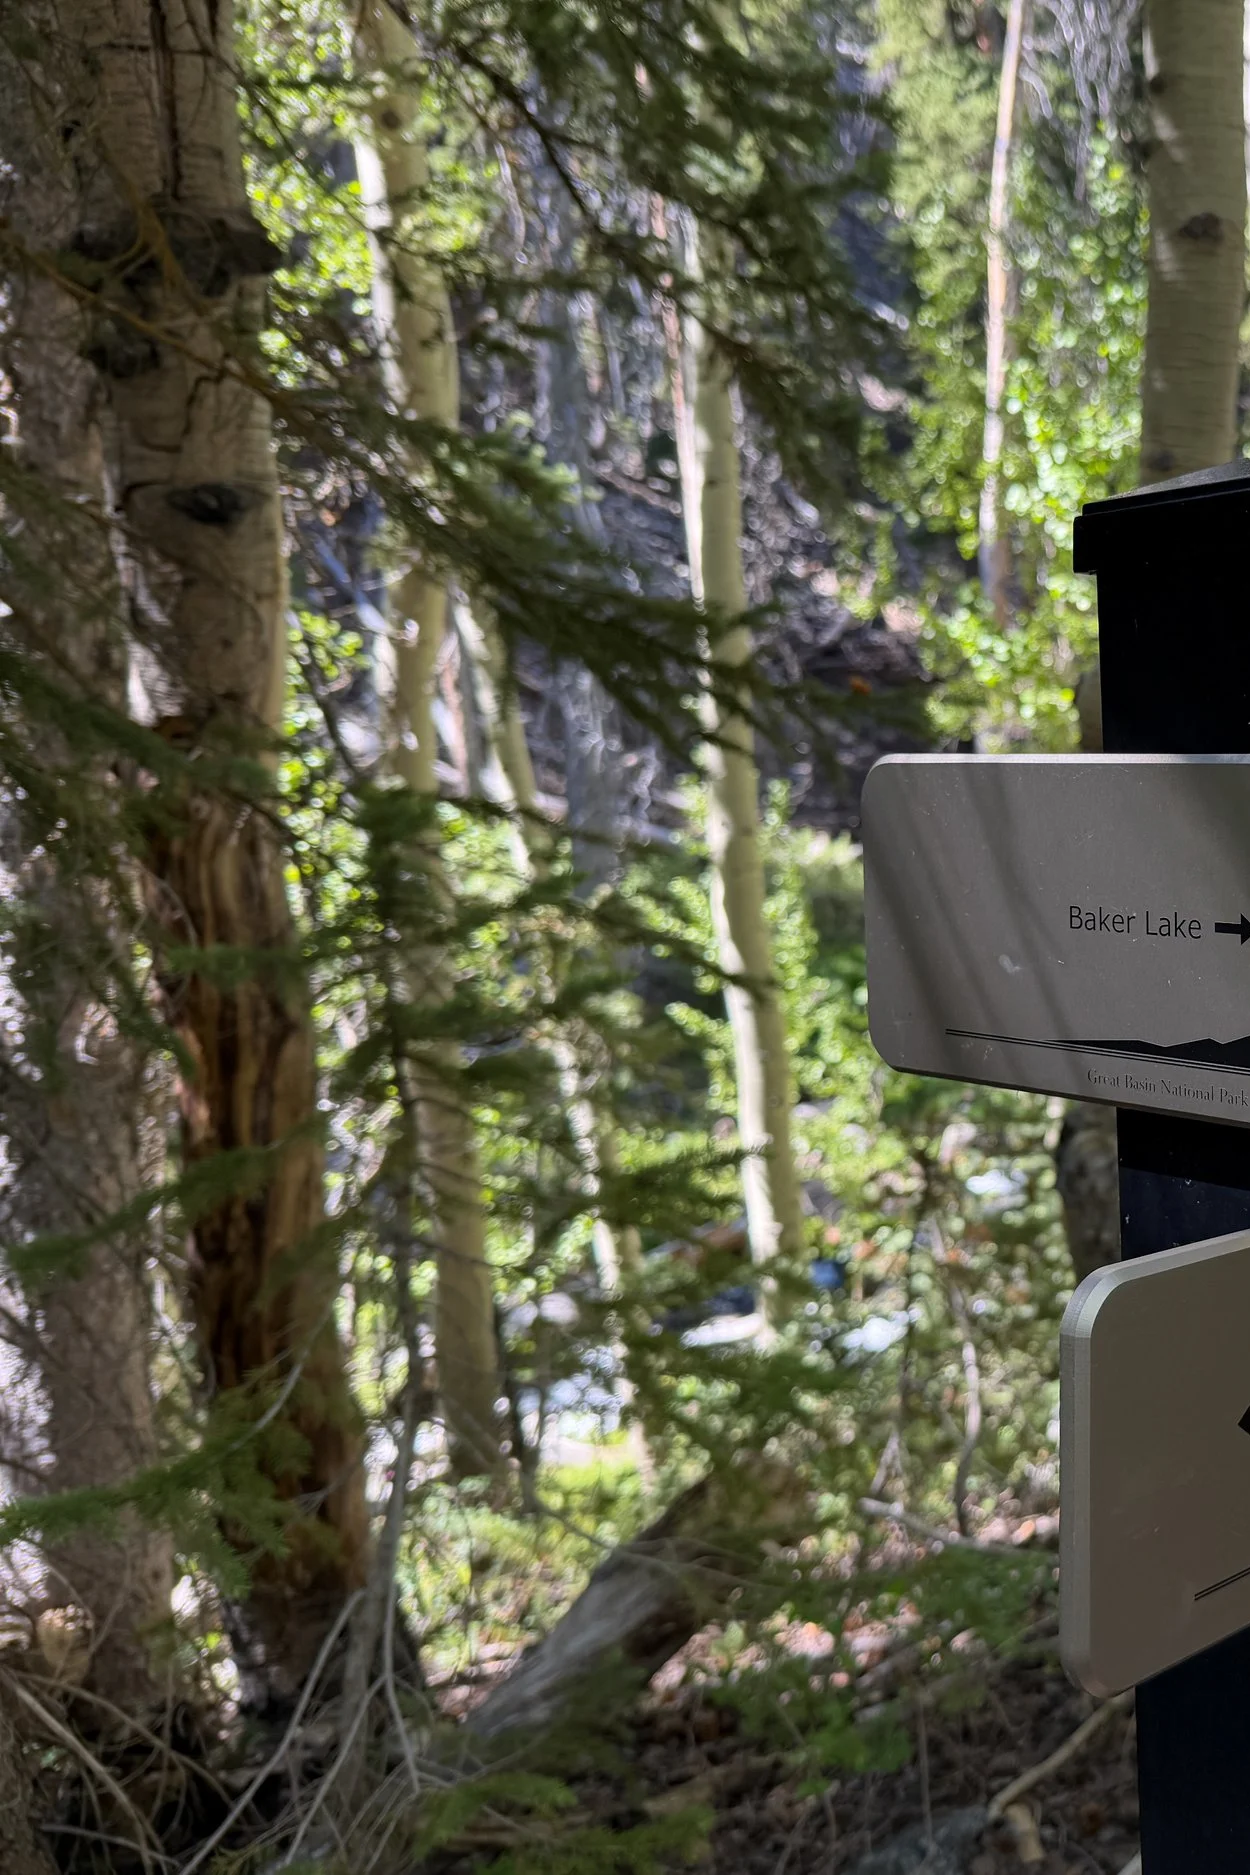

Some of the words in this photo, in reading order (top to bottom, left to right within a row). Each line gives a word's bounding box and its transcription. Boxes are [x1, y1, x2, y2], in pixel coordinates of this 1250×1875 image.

[1068, 905, 1136, 934] Baker
[1145, 910, 1202, 940] Lake
[1087, 1068, 1121, 1089] Great
[1125, 1074, 1157, 1094] Basin
[1160, 1079, 1214, 1102] National
[1220, 1088, 1249, 1107] Park
